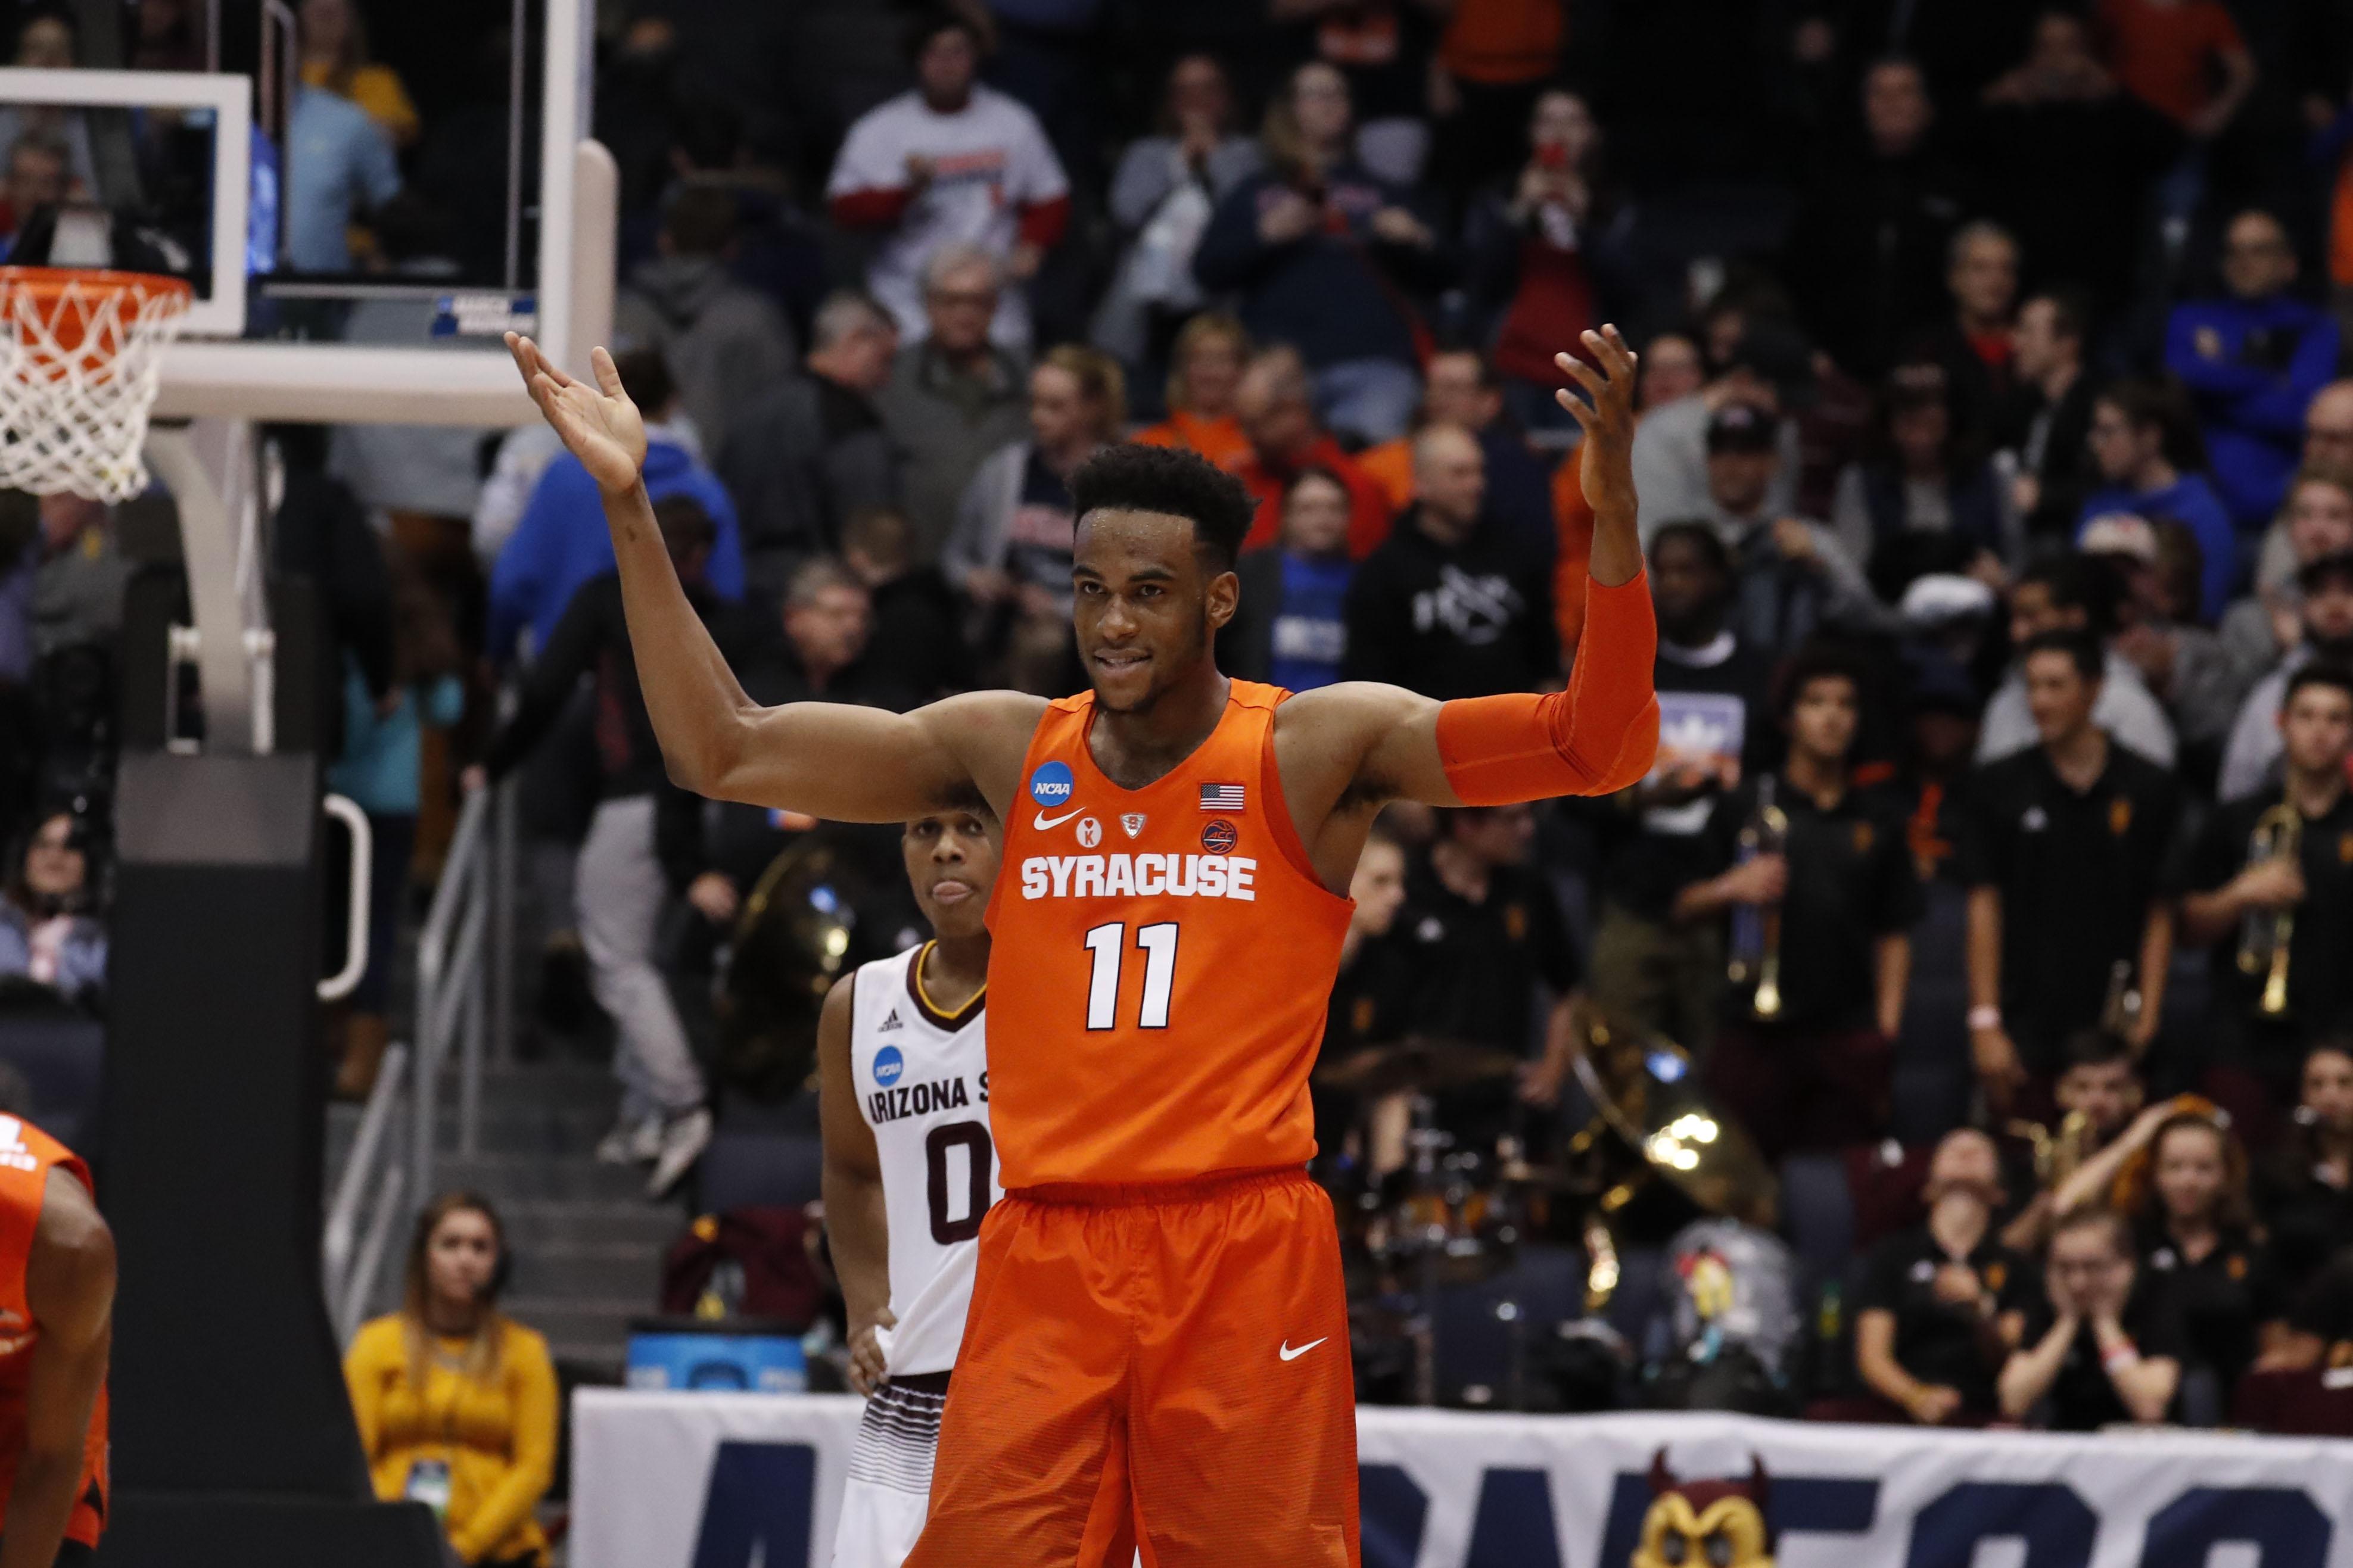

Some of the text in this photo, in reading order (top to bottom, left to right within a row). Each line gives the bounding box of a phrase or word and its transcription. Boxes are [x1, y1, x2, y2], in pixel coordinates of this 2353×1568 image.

[1035, 783, 1070, 795] NCAA
[1084, 830, 1094, 845] K
[1207, 831, 1235, 840] ACC
[1021, 853, 1258, 902] SYRACUSE
[1084, 921, 1179, 1031] 11
[926, 1120, 992, 1245] 0
